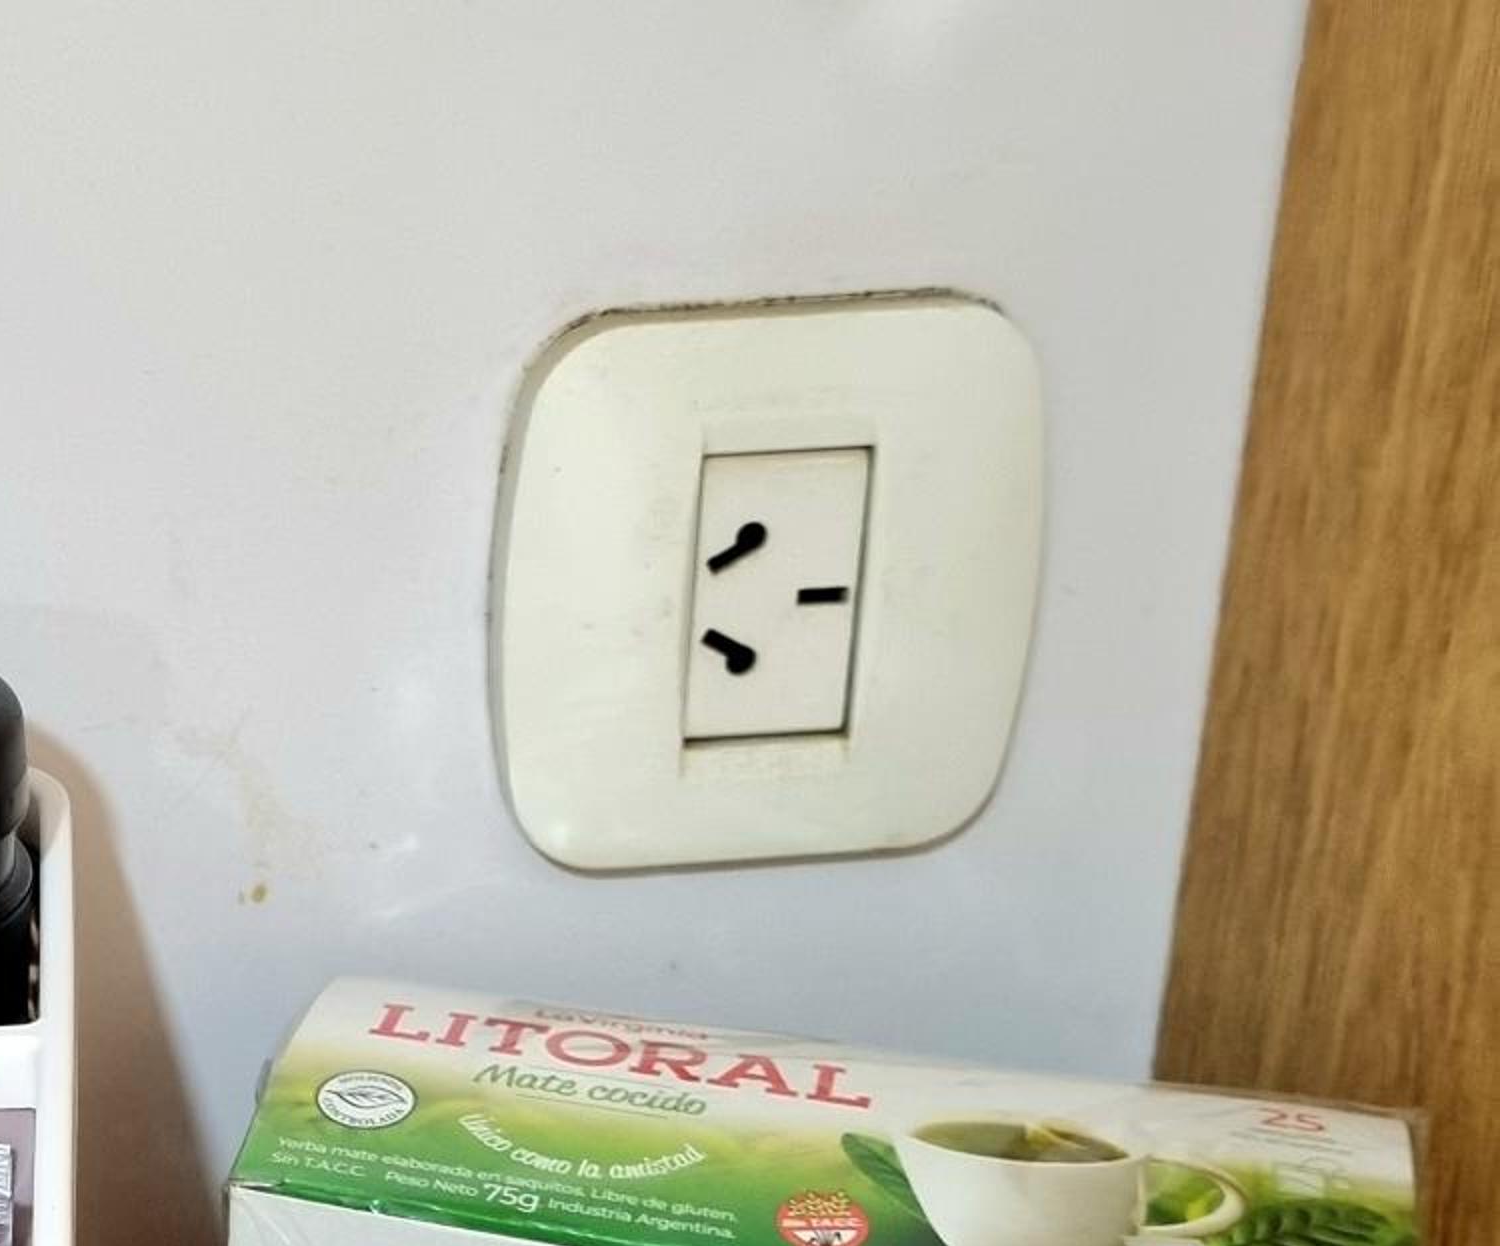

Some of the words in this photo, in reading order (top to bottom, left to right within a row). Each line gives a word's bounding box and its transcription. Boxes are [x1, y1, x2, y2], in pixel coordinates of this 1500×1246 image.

[368, 1002, 872, 1110] LITORAL
[472, 1063, 578, 1096] Mate
[587, 1084, 707, 1115] cocido
[1258, 1106, 1325, 1132] 25
[271, 1150, 299, 1166] Sin
[384, 1171, 430, 1188] Peso
[432, 1178, 479, 1197] Neto
[483, 1183, 540, 1213] 75g
[547, 1197, 631, 1222] Industria
[278, 1136, 327, 1154] Yerba
[331, 1146, 378, 1162] mate
[381, 1155, 474, 1179] elaborada
[477, 1169, 500, 1182] en
[591, 1186, 638, 1206] Libre
[642, 1197, 668, 1212] de
[510, 1149, 573, 1175] como
[577, 1158, 603, 1179] la
[608, 1142, 707, 1179] amistad
